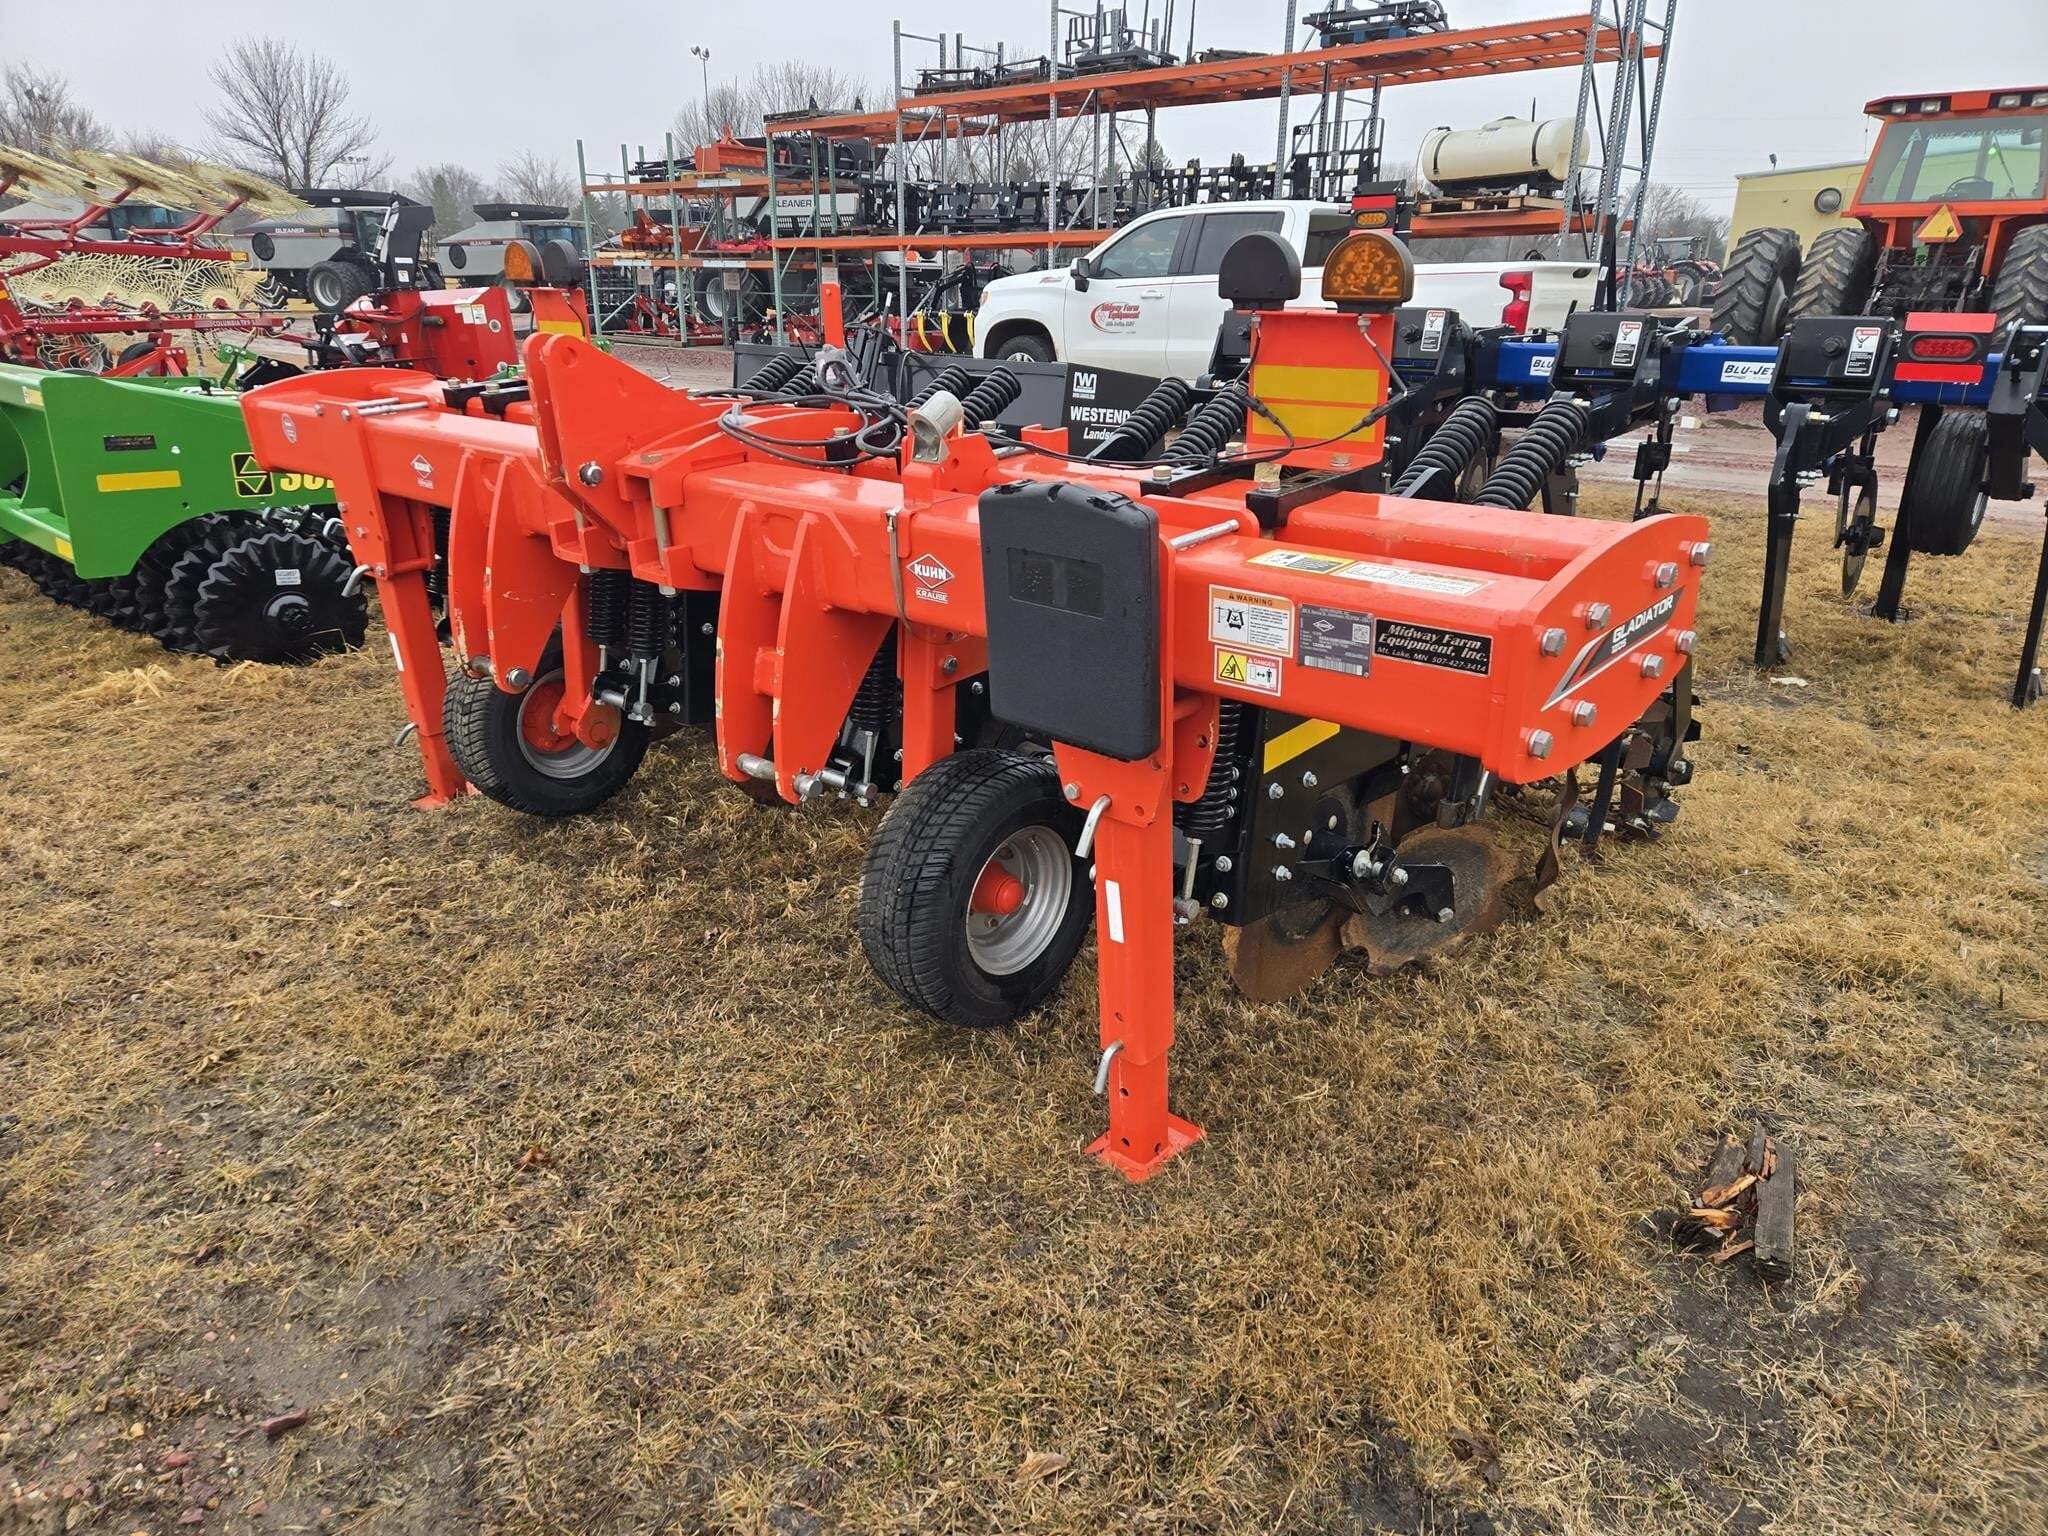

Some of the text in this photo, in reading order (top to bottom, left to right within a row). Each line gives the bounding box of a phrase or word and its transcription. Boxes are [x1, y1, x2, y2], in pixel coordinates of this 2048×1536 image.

[777, 199, 812, 208] LEANER
[1533, 359, 1554, 368] BLU
[1070, 405, 1131, 424] WESTEND
[914, 563, 947, 580] KUHN
[916, 588, 948, 602] KRAUSE
[1236, 594, 1273, 607] WARNING
[1612, 595, 1674, 643] GLADIATOR
[1388, 623, 1482, 650] Midway Farm
[1379, 634, 1456, 657] Equipment,
[1460, 648, 1489, 662] Inc.
[1414, 652, 1428, 662] MN
